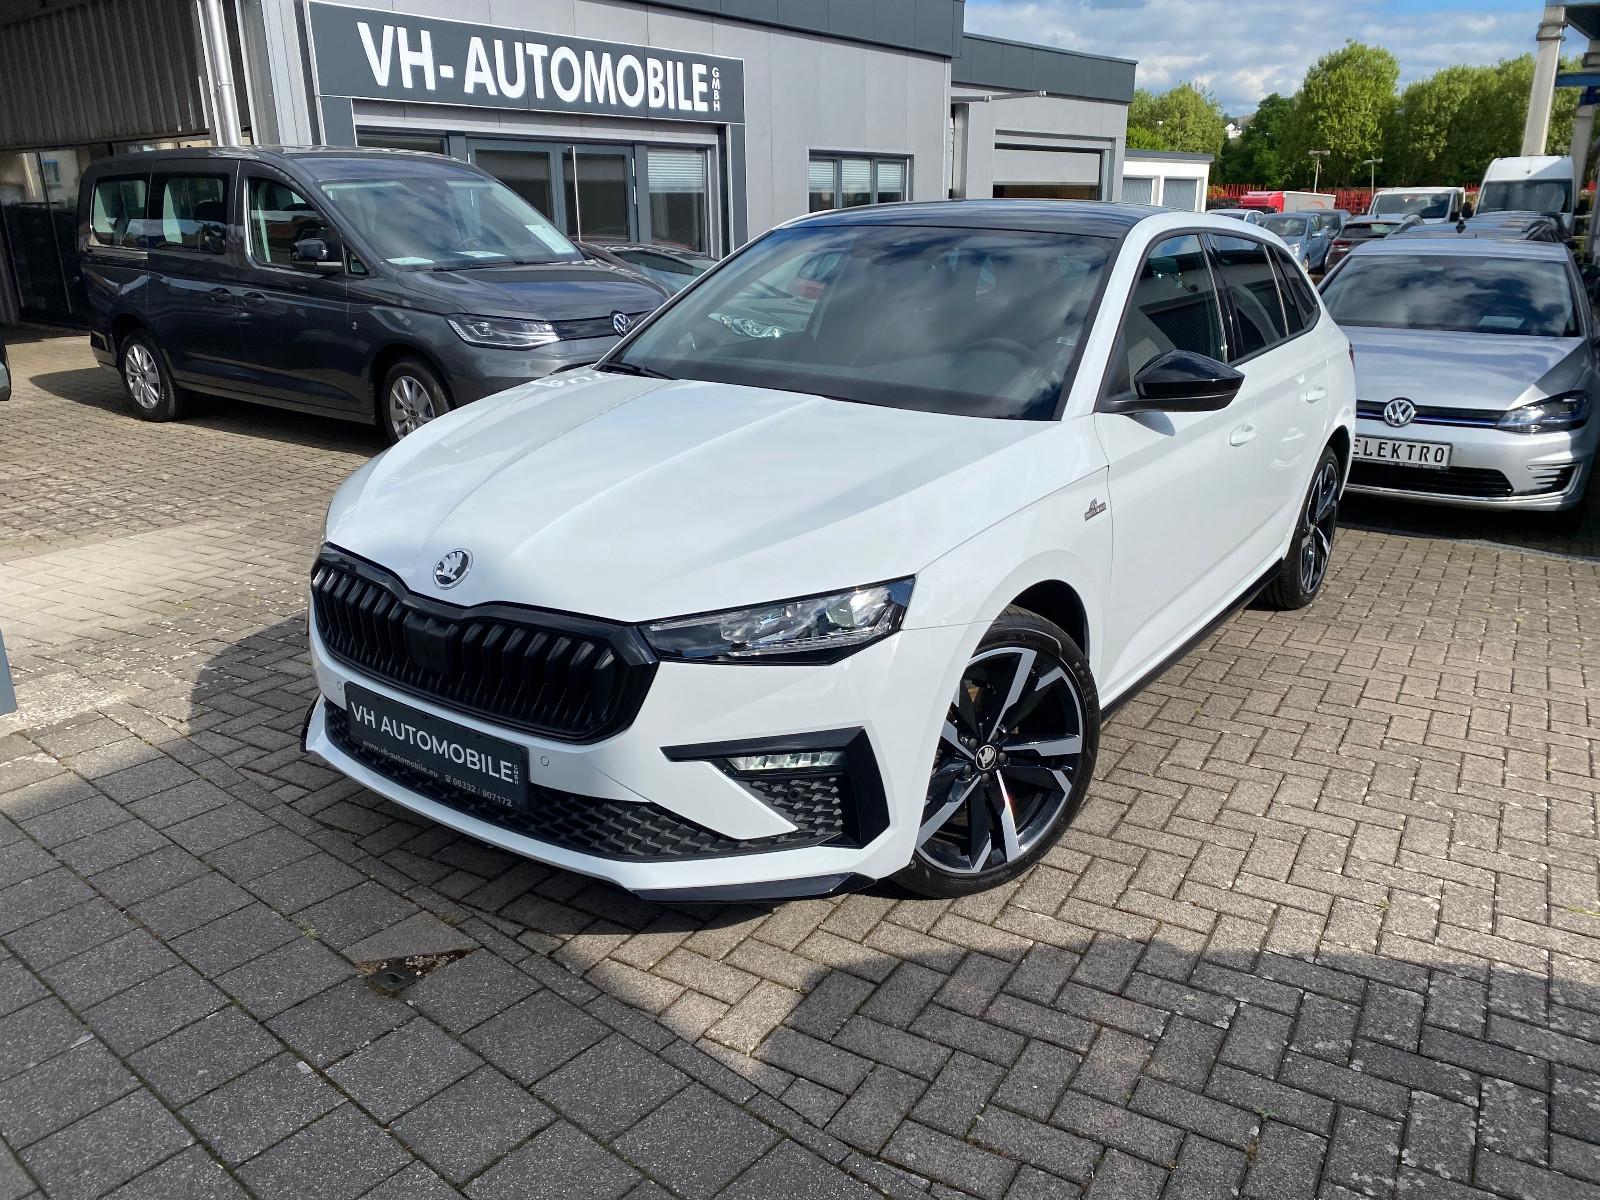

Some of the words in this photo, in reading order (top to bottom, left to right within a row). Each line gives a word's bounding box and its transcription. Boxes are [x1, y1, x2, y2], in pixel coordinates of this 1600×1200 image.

[357, 22, 454, 91] VH-
[464, 36, 708, 112] AUTOMOBILE
[1353, 438, 1445, 463] ELEKTRO
[351, 701, 375, 729] VH
[380, 715, 514, 783] AUTOMOBILE
